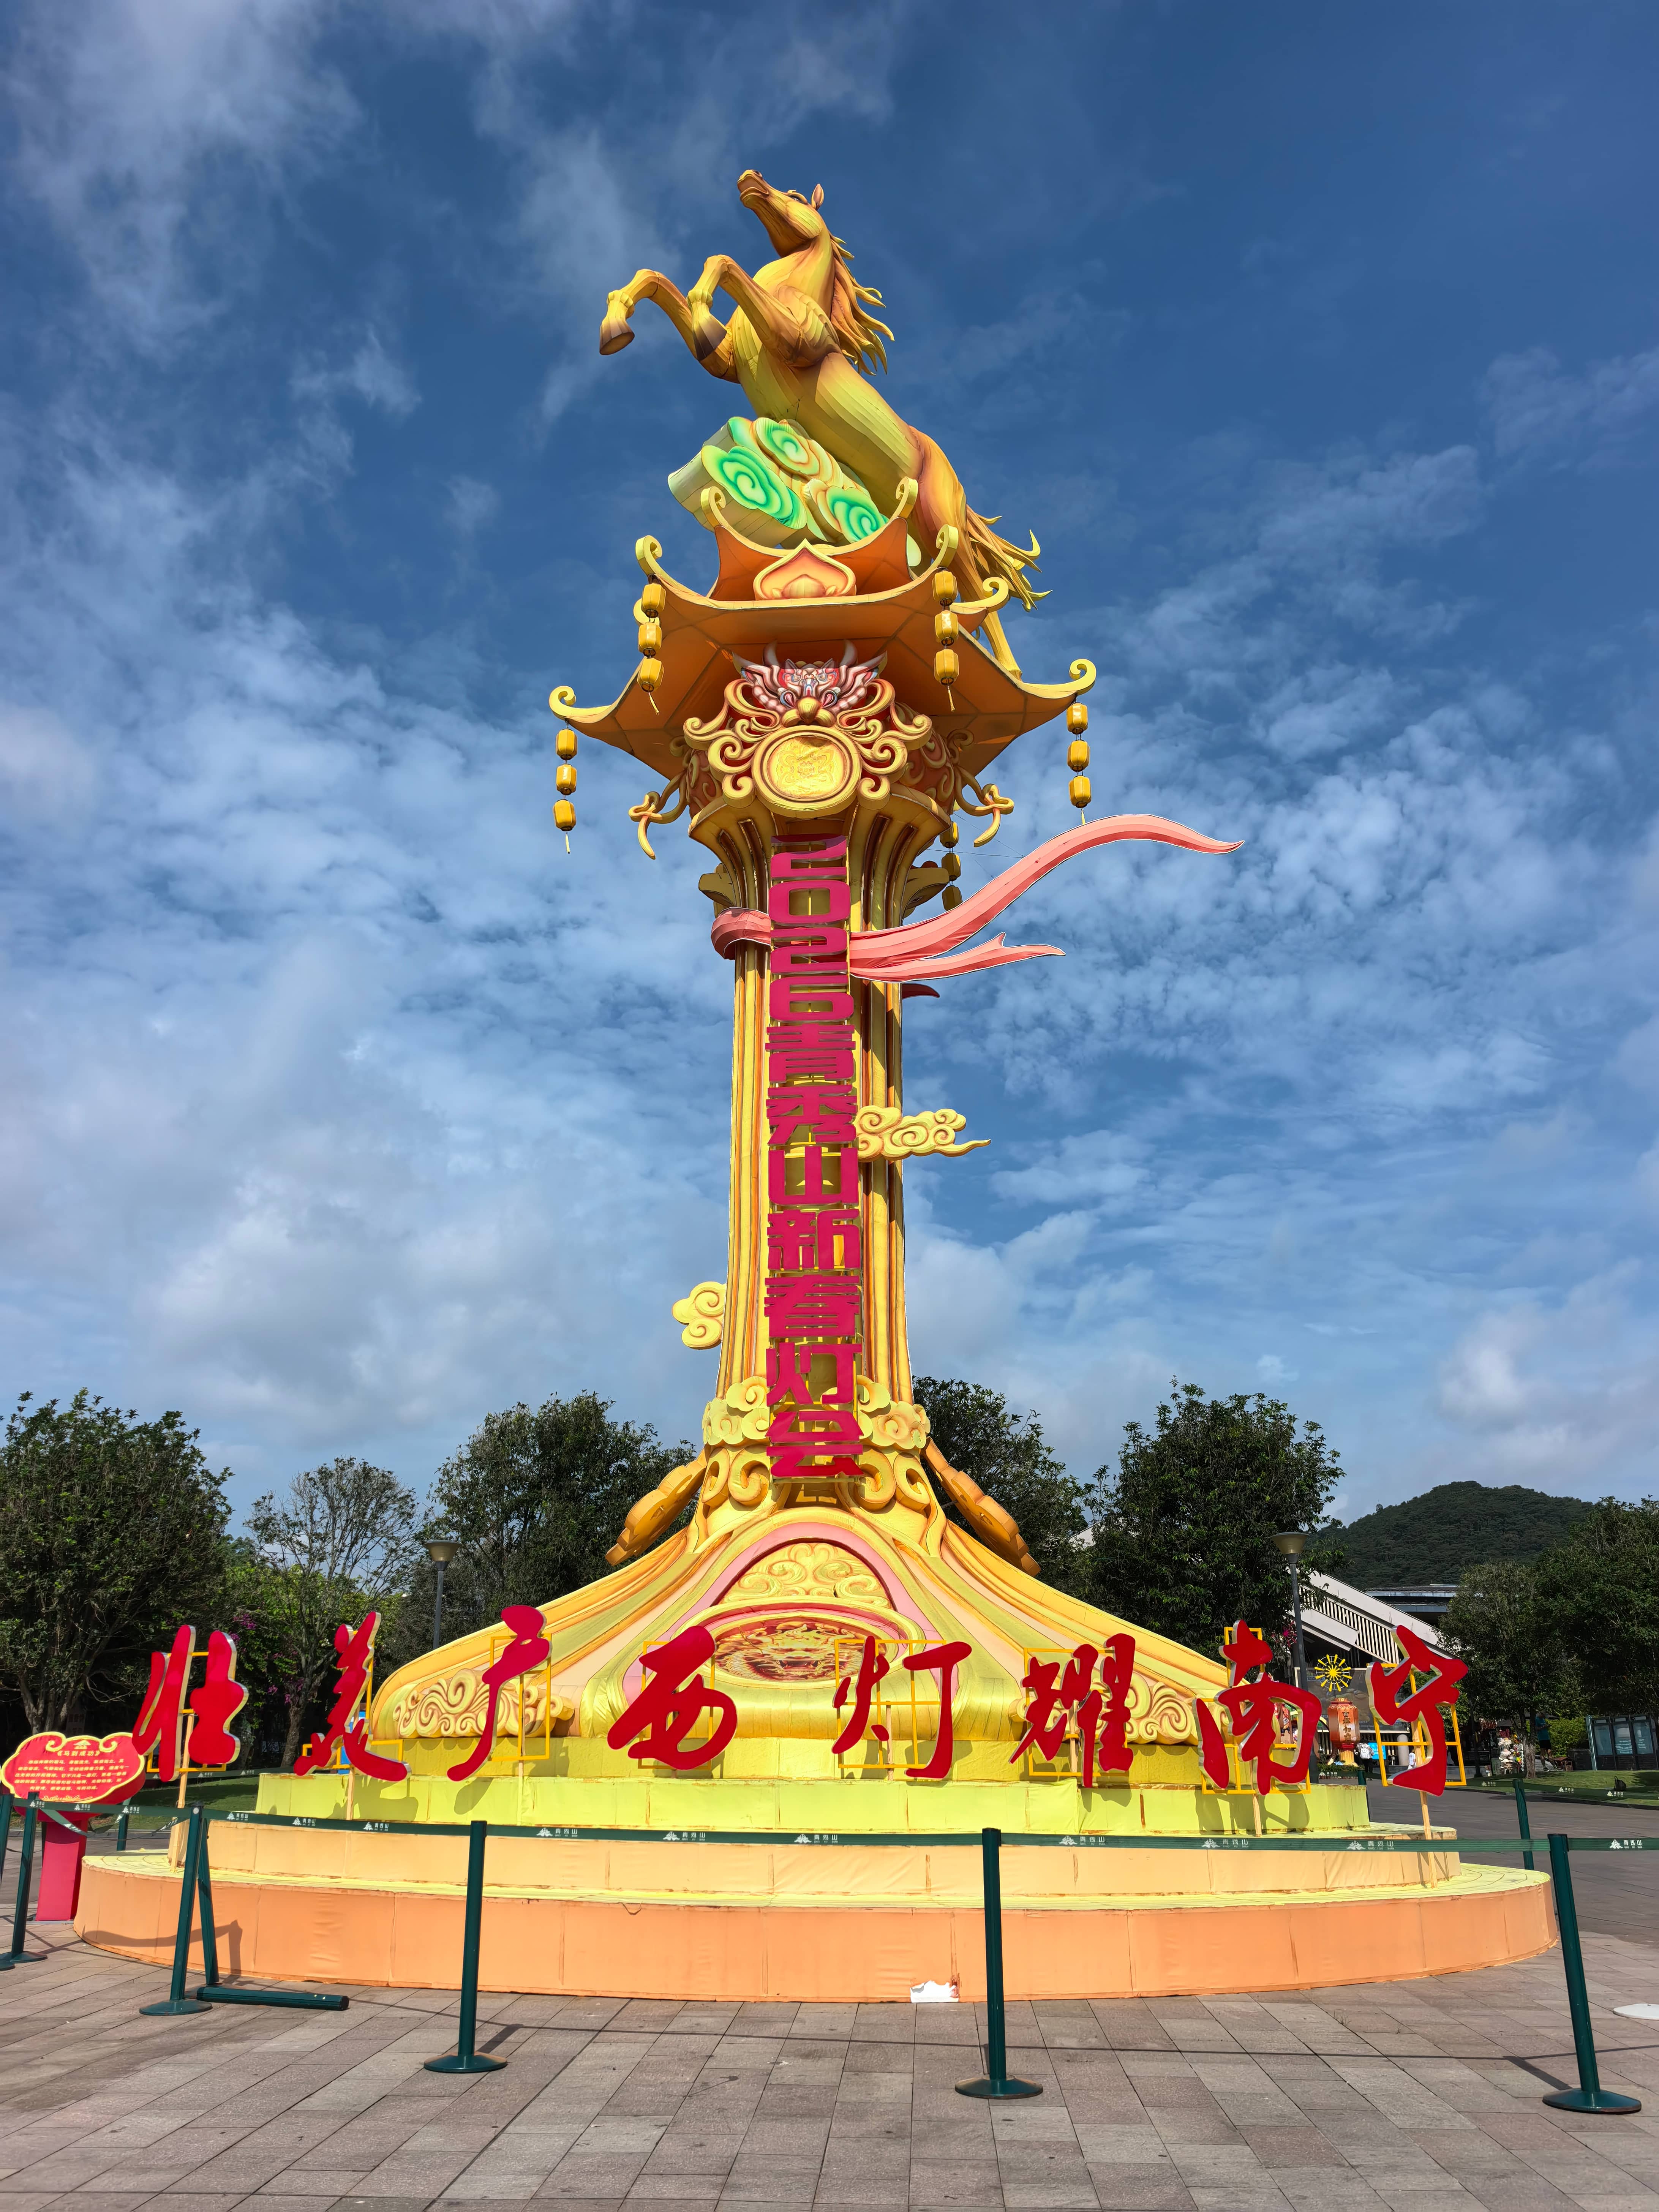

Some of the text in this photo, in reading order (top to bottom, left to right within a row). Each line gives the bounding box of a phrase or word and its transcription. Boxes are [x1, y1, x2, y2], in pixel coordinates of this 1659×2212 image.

[765, 834, 864, 1477] 2026青秀山新春灯会
